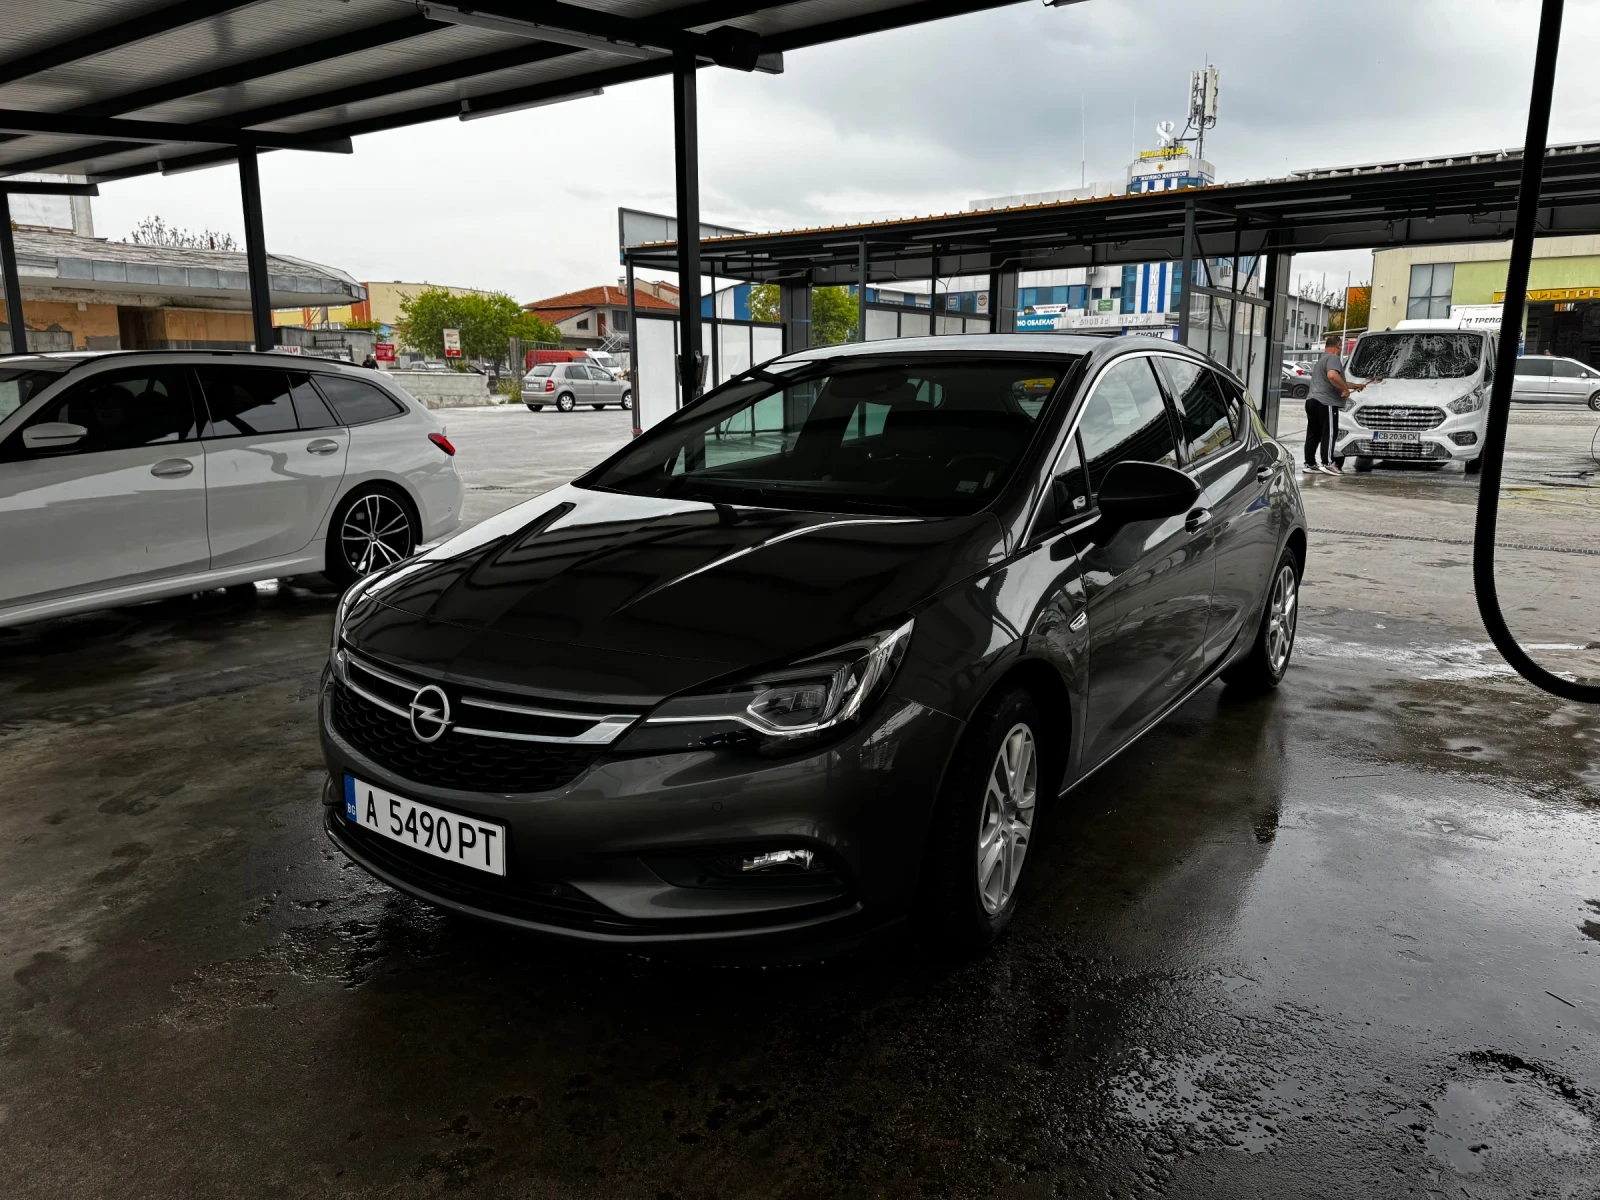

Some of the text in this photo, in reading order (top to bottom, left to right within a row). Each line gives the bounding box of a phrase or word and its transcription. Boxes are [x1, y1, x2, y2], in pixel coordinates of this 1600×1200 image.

[1027, 318, 1055, 326] ОБЛЕКЛО
[1389, 432, 1407, 440] 2038
[347, 803, 356, 815] BG
[366, 790, 497, 867] A 5490 PT
